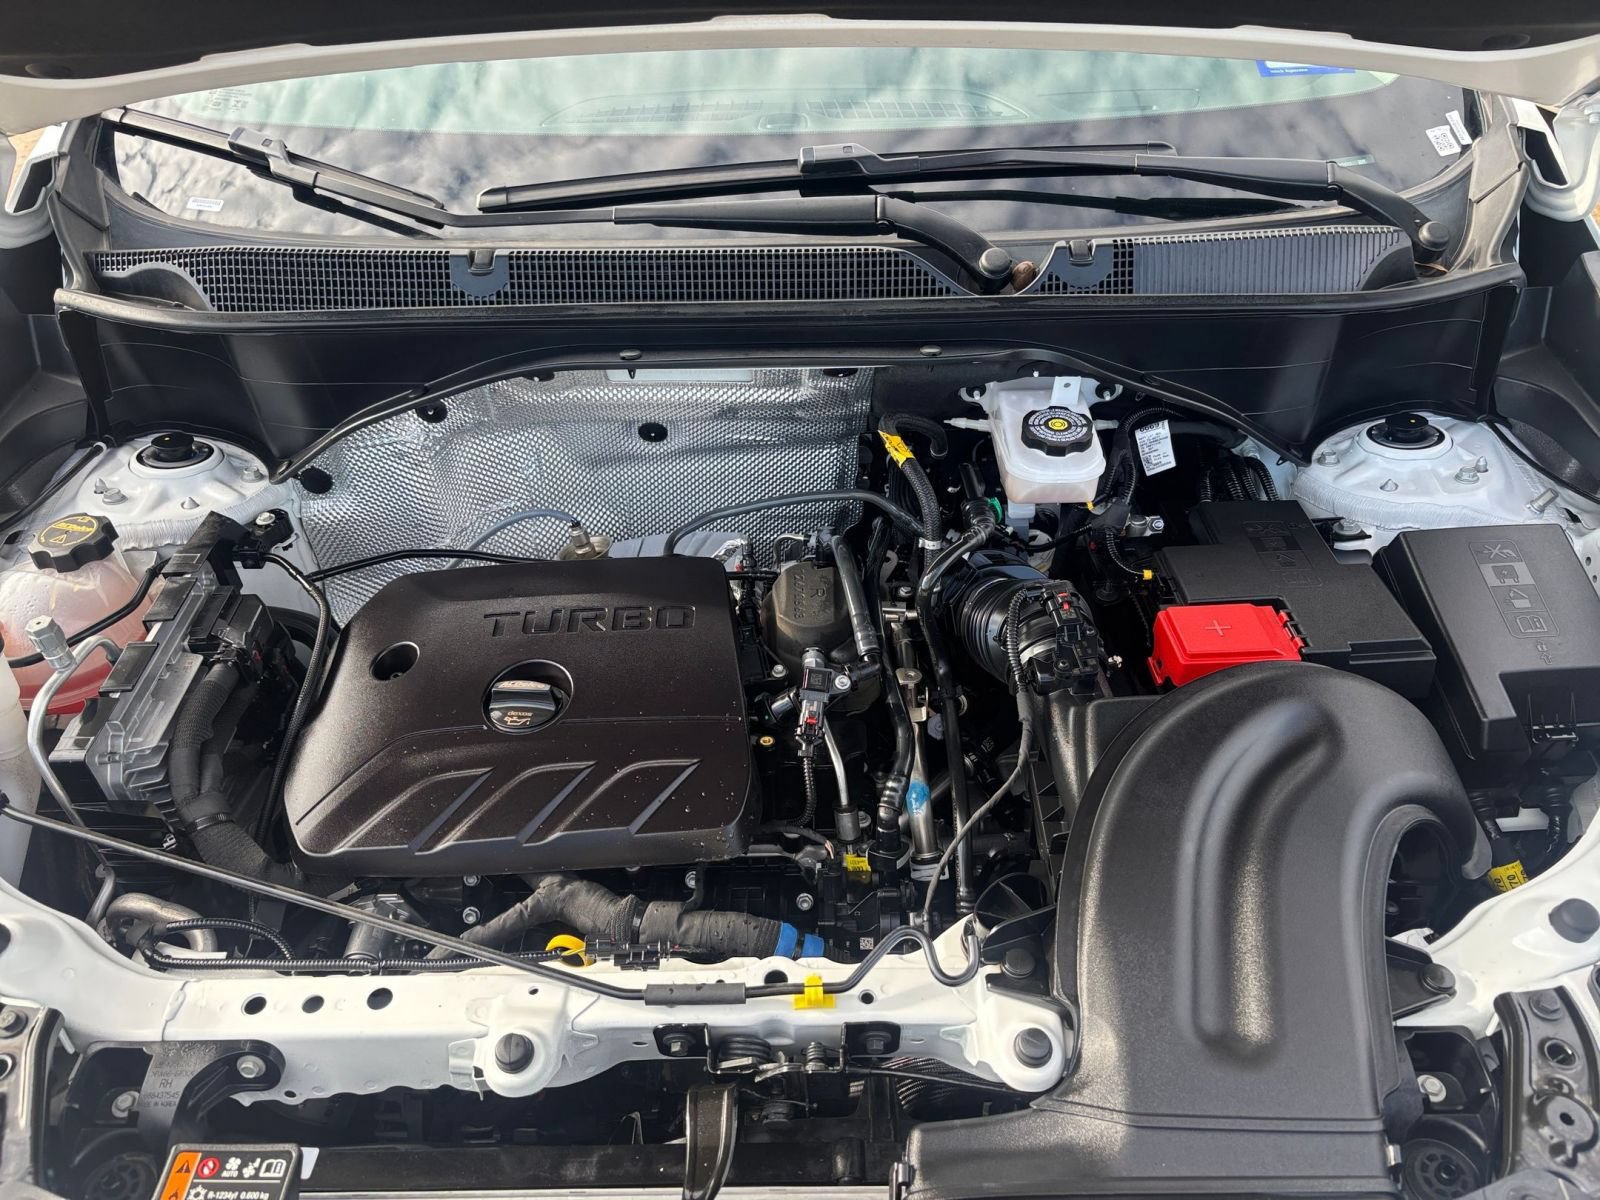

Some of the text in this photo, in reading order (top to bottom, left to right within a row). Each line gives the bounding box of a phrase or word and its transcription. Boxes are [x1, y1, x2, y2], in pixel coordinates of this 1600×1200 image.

[484, 605, 696, 638] TURBO
[159, 1079, 173, 1088] RH
[221, 1170, 239, 1178] AUTO
[207, 1191, 238, 1200] R-1234yf
[260, 1191, 269, 1200] kg
